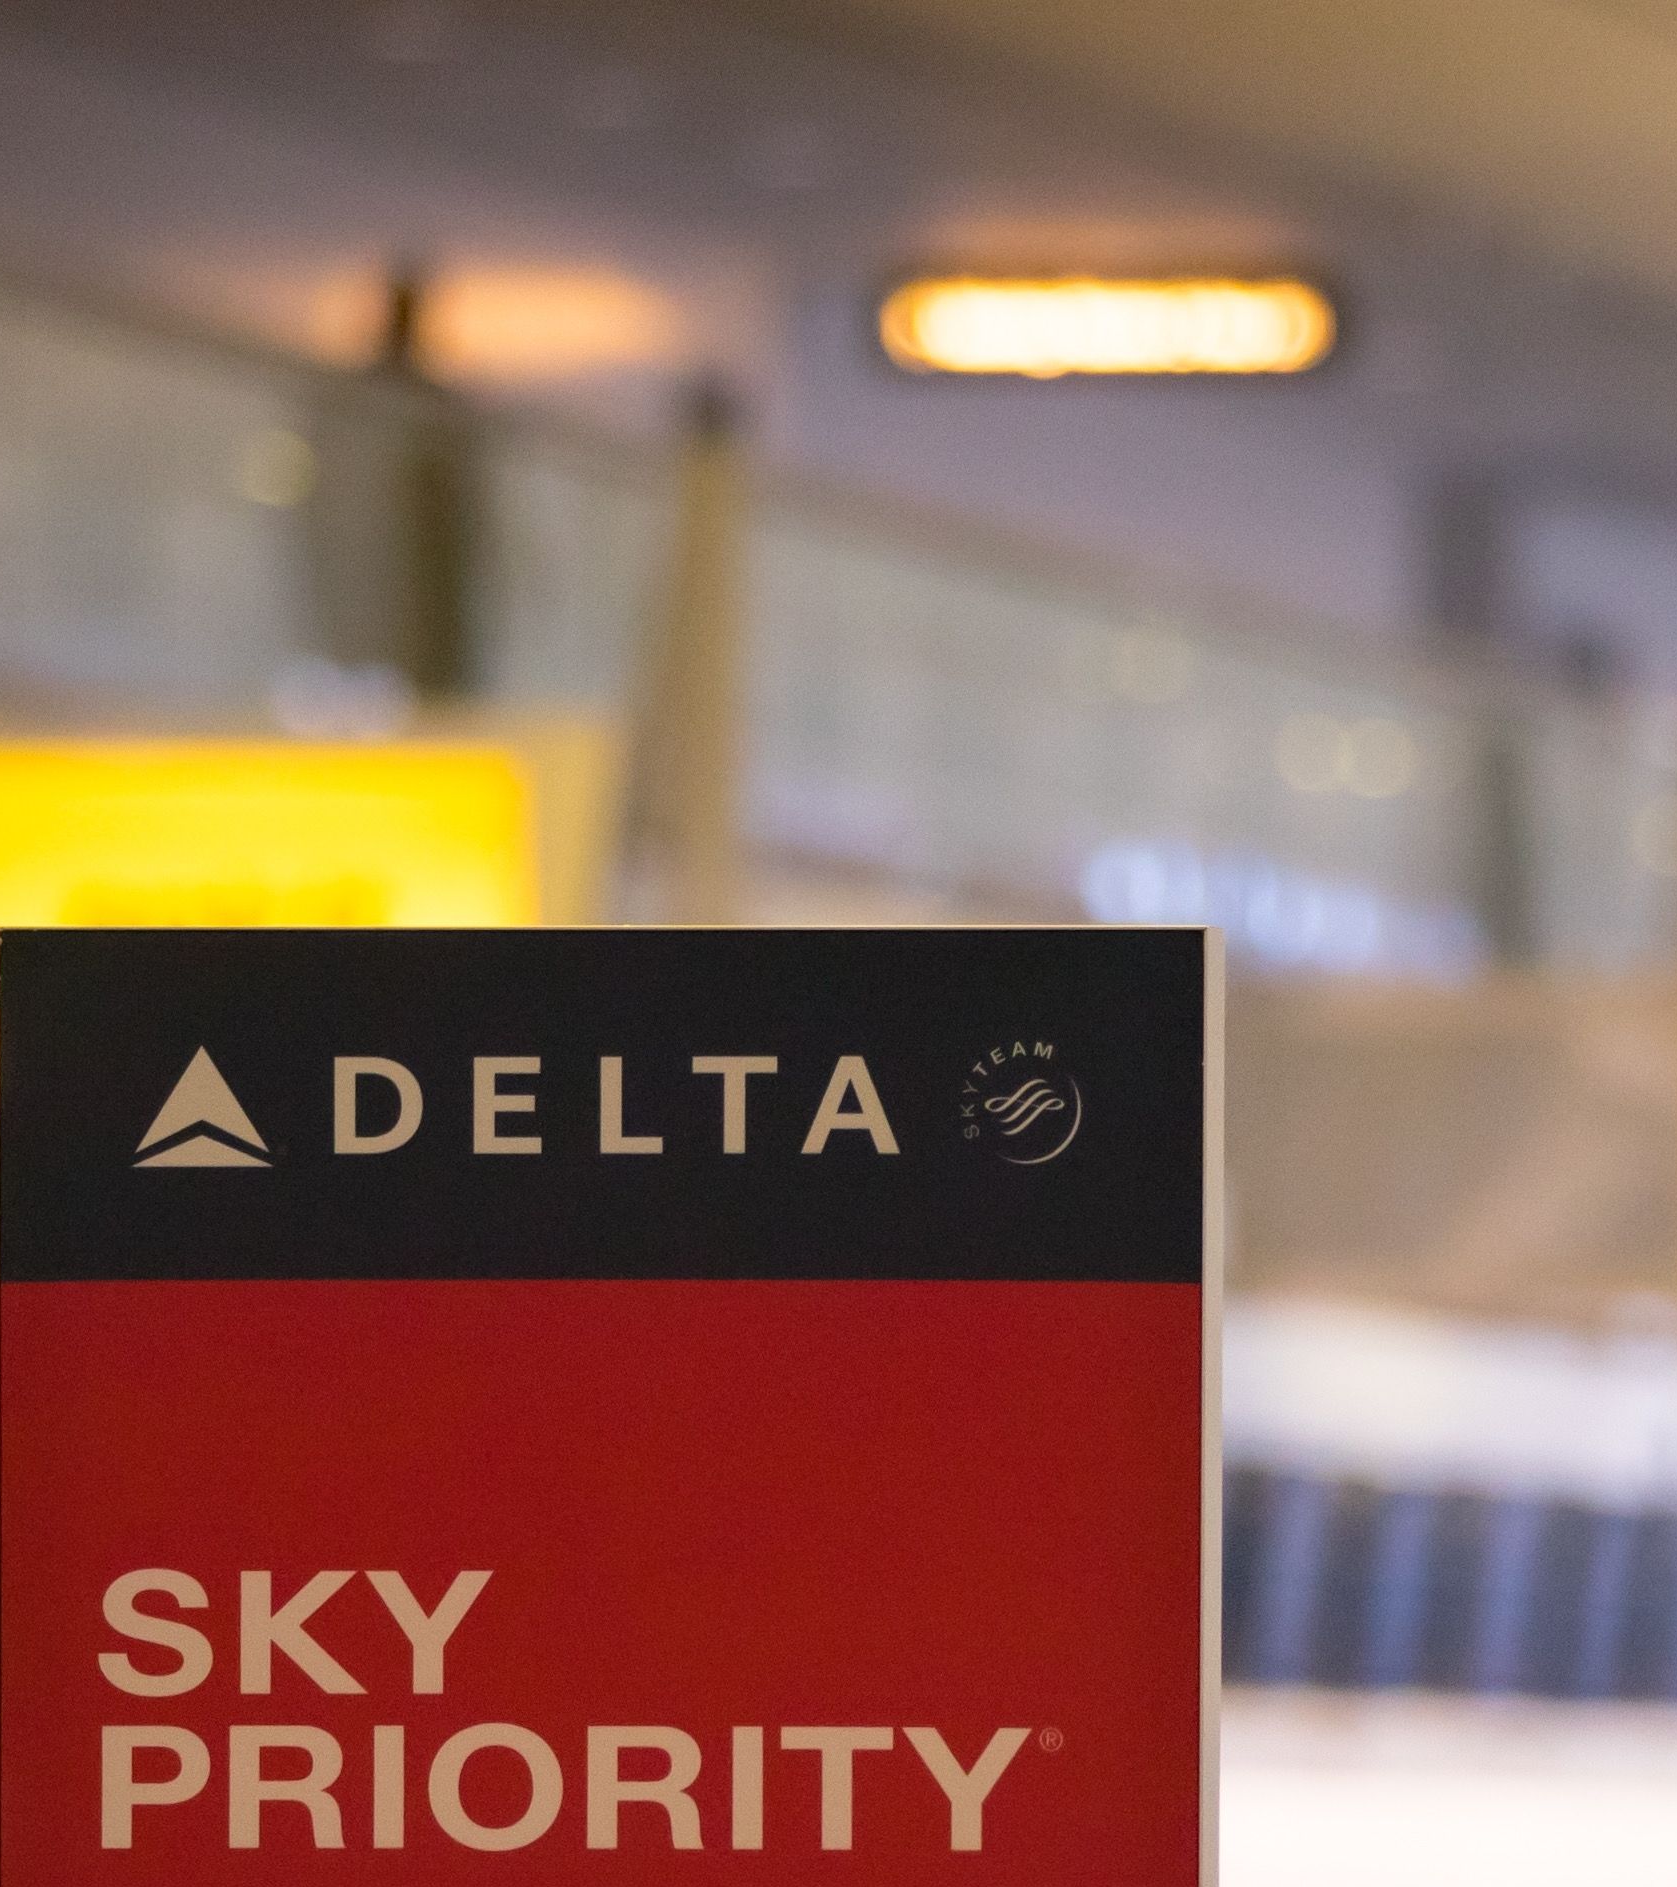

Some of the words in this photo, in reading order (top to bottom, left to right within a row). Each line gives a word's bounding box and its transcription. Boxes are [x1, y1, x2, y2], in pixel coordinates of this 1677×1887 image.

[334, 1056, 900, 1155] DELTA
[961, 1041, 1054, 1140] SKYTEAM
[97, 1567, 493, 1698] SKY
